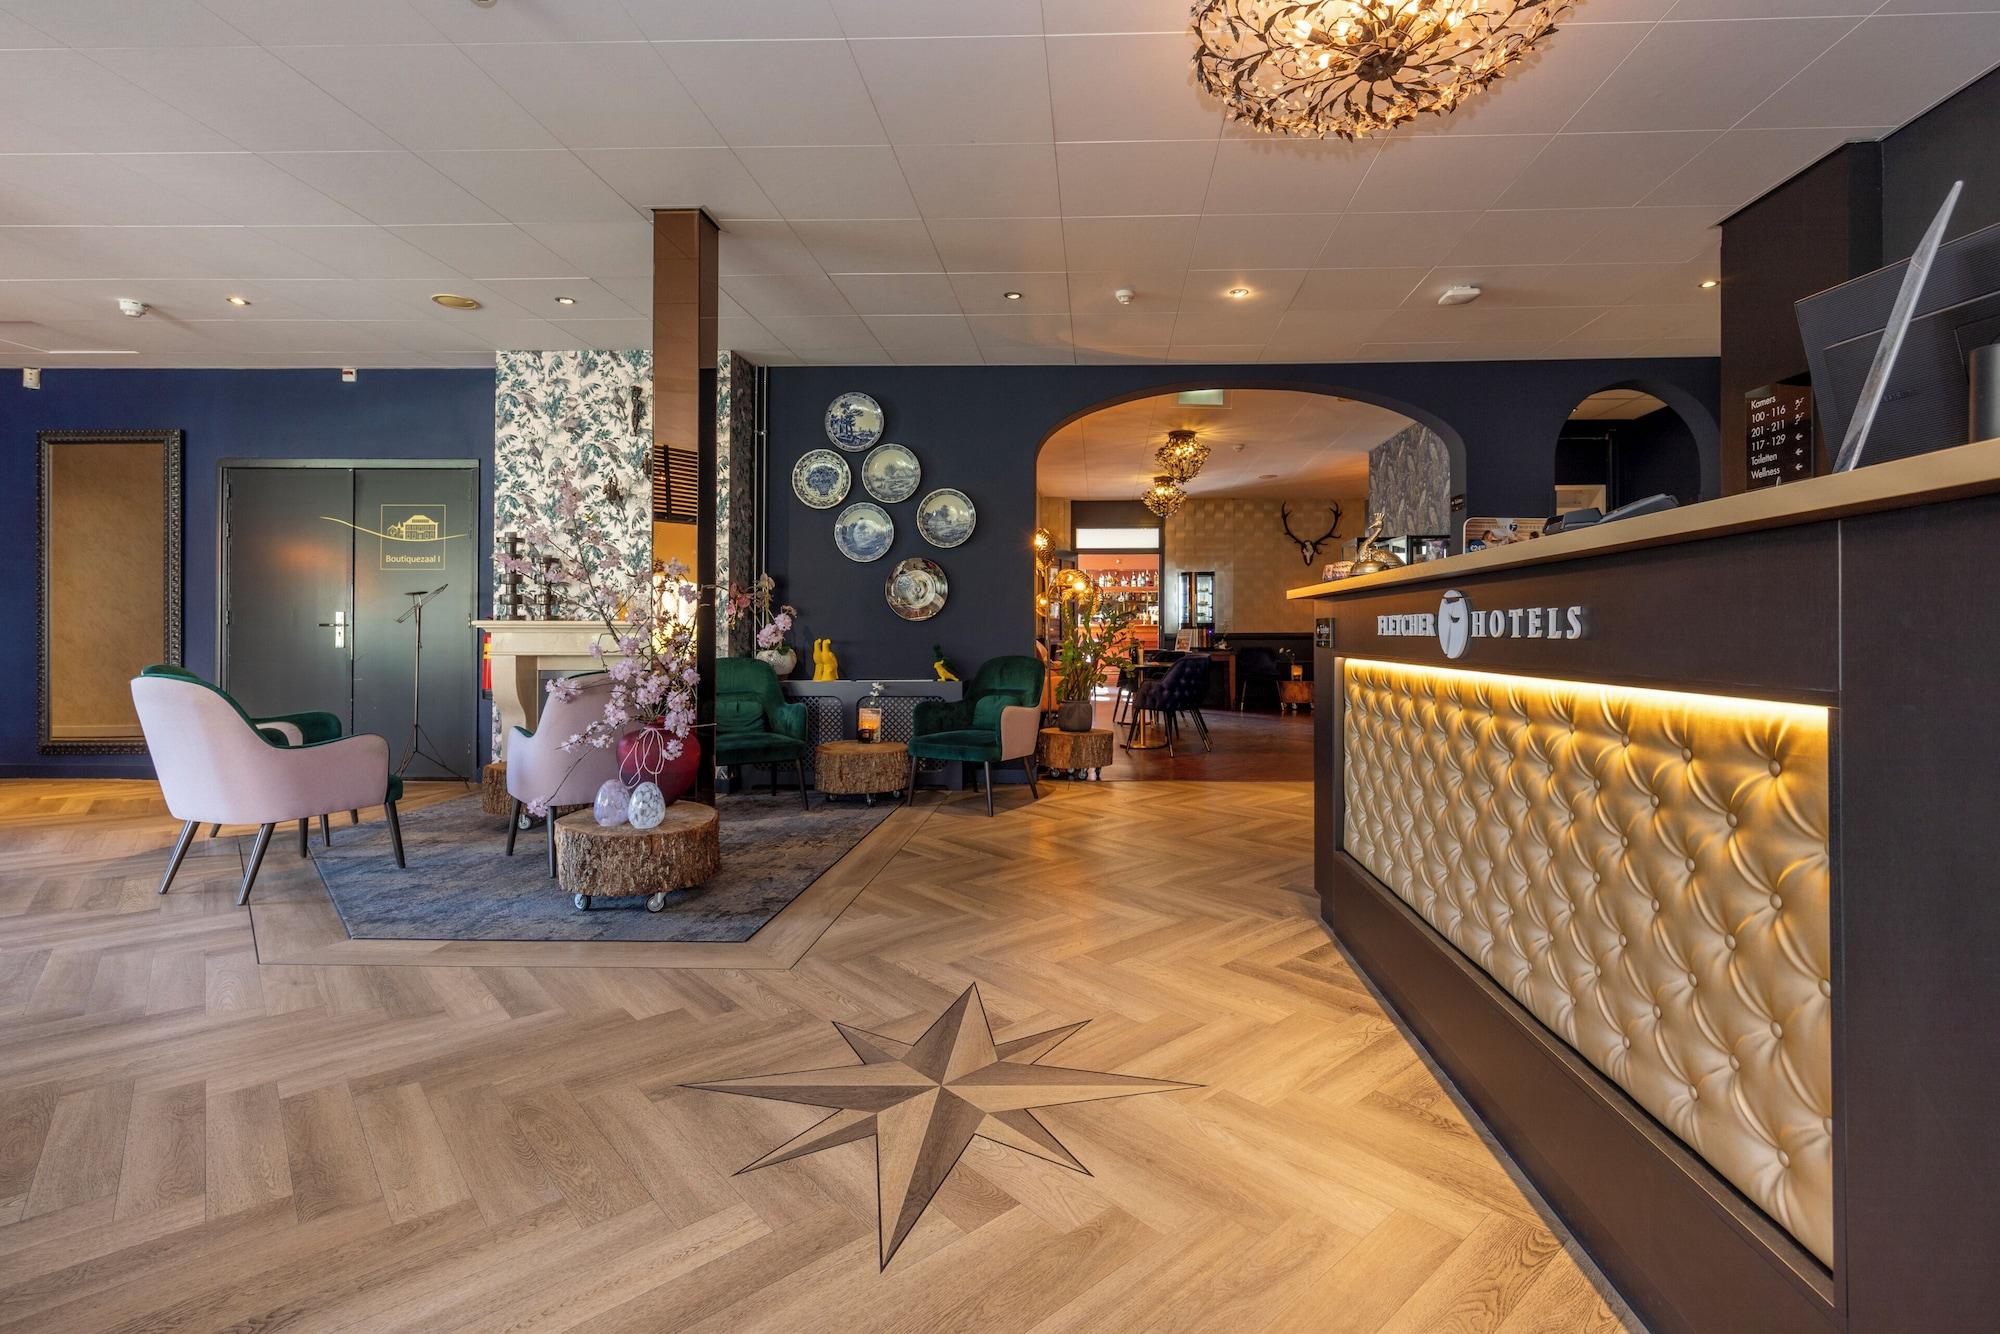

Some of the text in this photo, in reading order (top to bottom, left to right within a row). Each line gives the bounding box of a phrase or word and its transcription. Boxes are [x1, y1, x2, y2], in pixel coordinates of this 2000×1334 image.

[1751, 395, 1776, 410] Kamers
[1751, 411, 1765, 424] 100
[1771, 405, 1786, 417] 116
[1751, 425, 1764, 438] 201
[1771, 419, 1785, 432] 211
[1751, 440, 1765, 452] 117
[1771, 434, 1786, 446] 129
[1750, 453, 1778, 466] Toiletten
[1750, 466, 1781, 479] Wellness
[385, 554, 436, 565] Boutiquezaal
[1376, 606, 1582, 640] FLETCHER HOTELS
